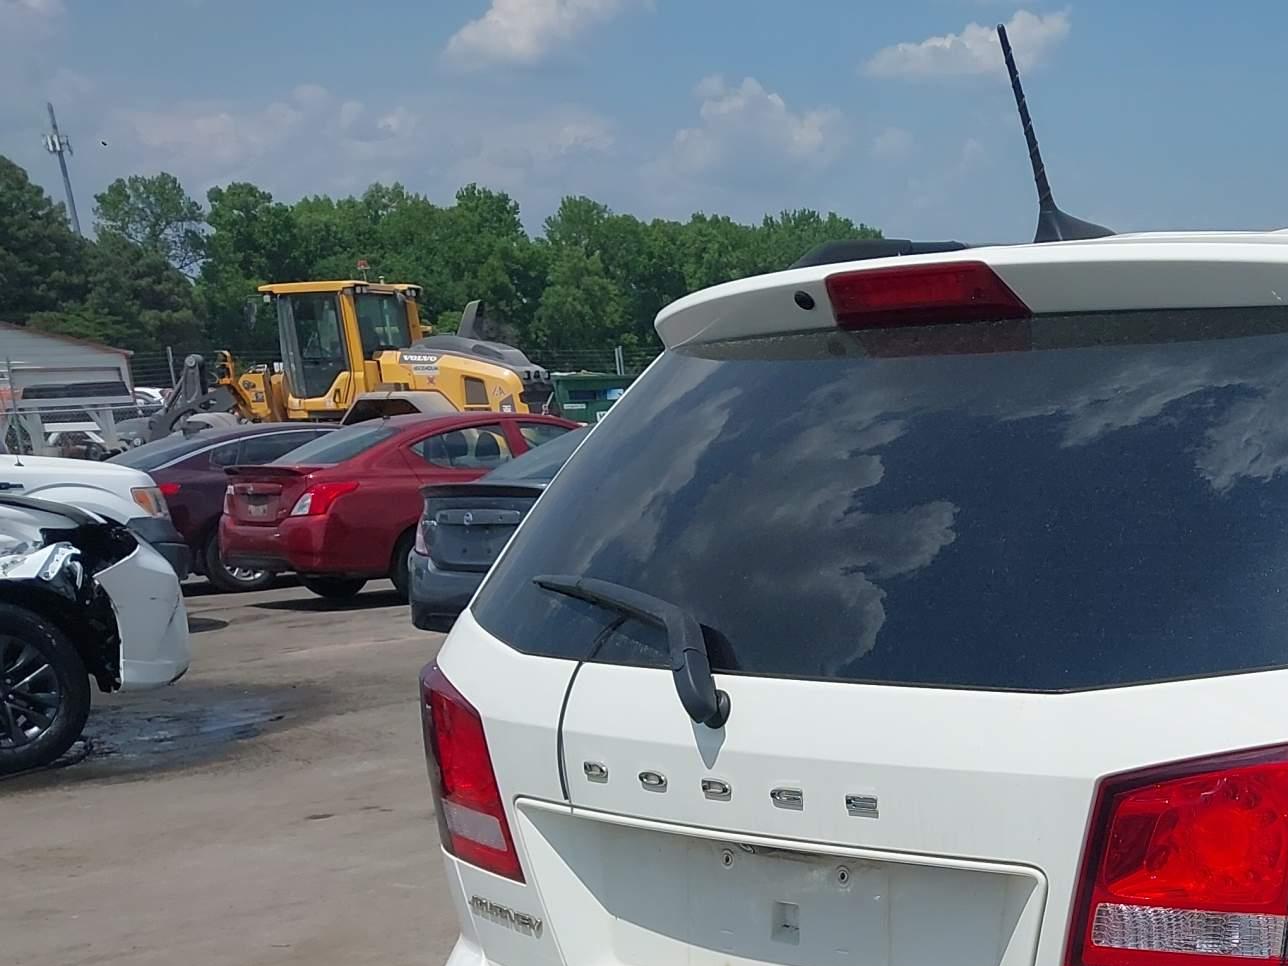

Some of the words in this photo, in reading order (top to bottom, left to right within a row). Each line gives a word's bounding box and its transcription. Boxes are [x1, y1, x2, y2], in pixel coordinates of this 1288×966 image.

[403, 354, 438, 362] VOLVO
[583, 760, 879, 815] DODGE
[468, 894, 543, 936] JOURNEY
